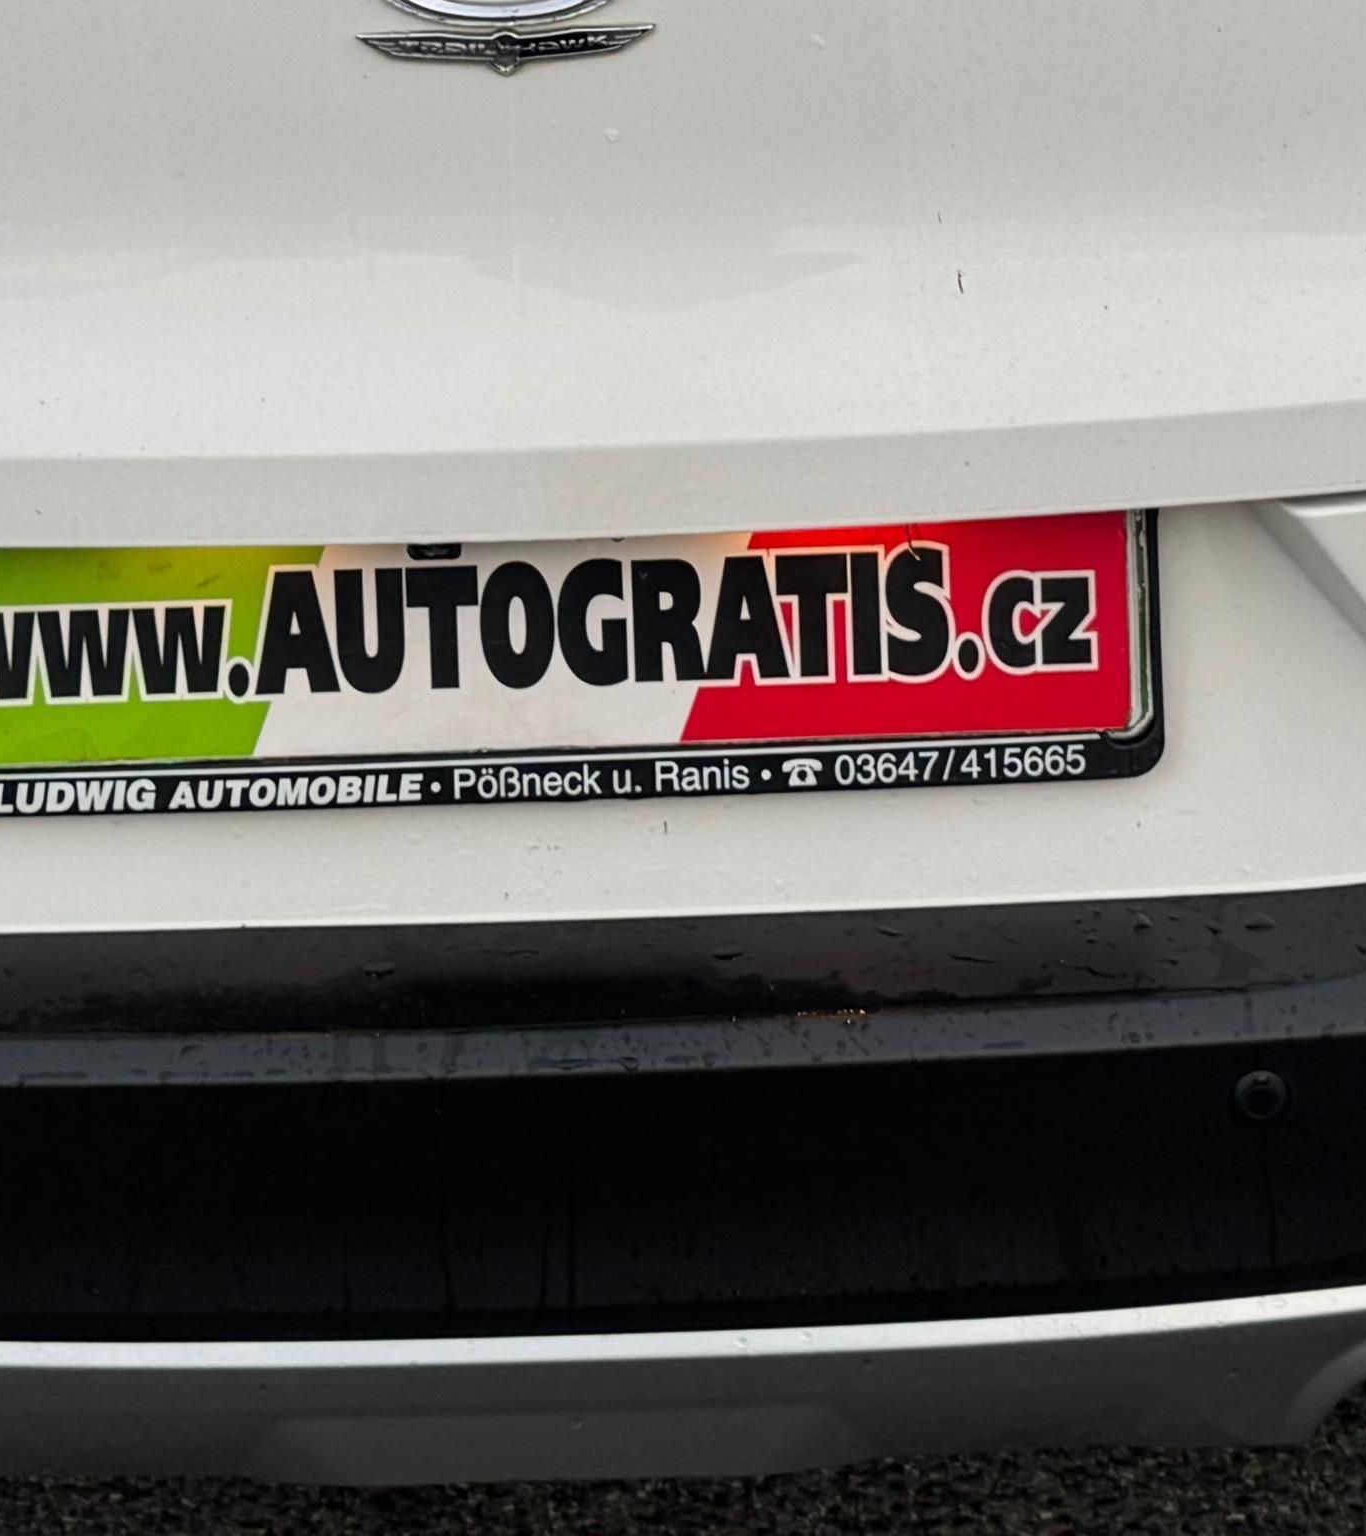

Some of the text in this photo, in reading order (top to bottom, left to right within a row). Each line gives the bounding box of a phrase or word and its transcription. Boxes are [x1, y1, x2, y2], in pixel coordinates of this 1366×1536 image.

[168, 772, 424, 810] AUTOMOBILE
[453, 763, 603, 799] Pößneck
[612, 769, 642, 793] u.
[654, 758, 750, 792] Ranis
